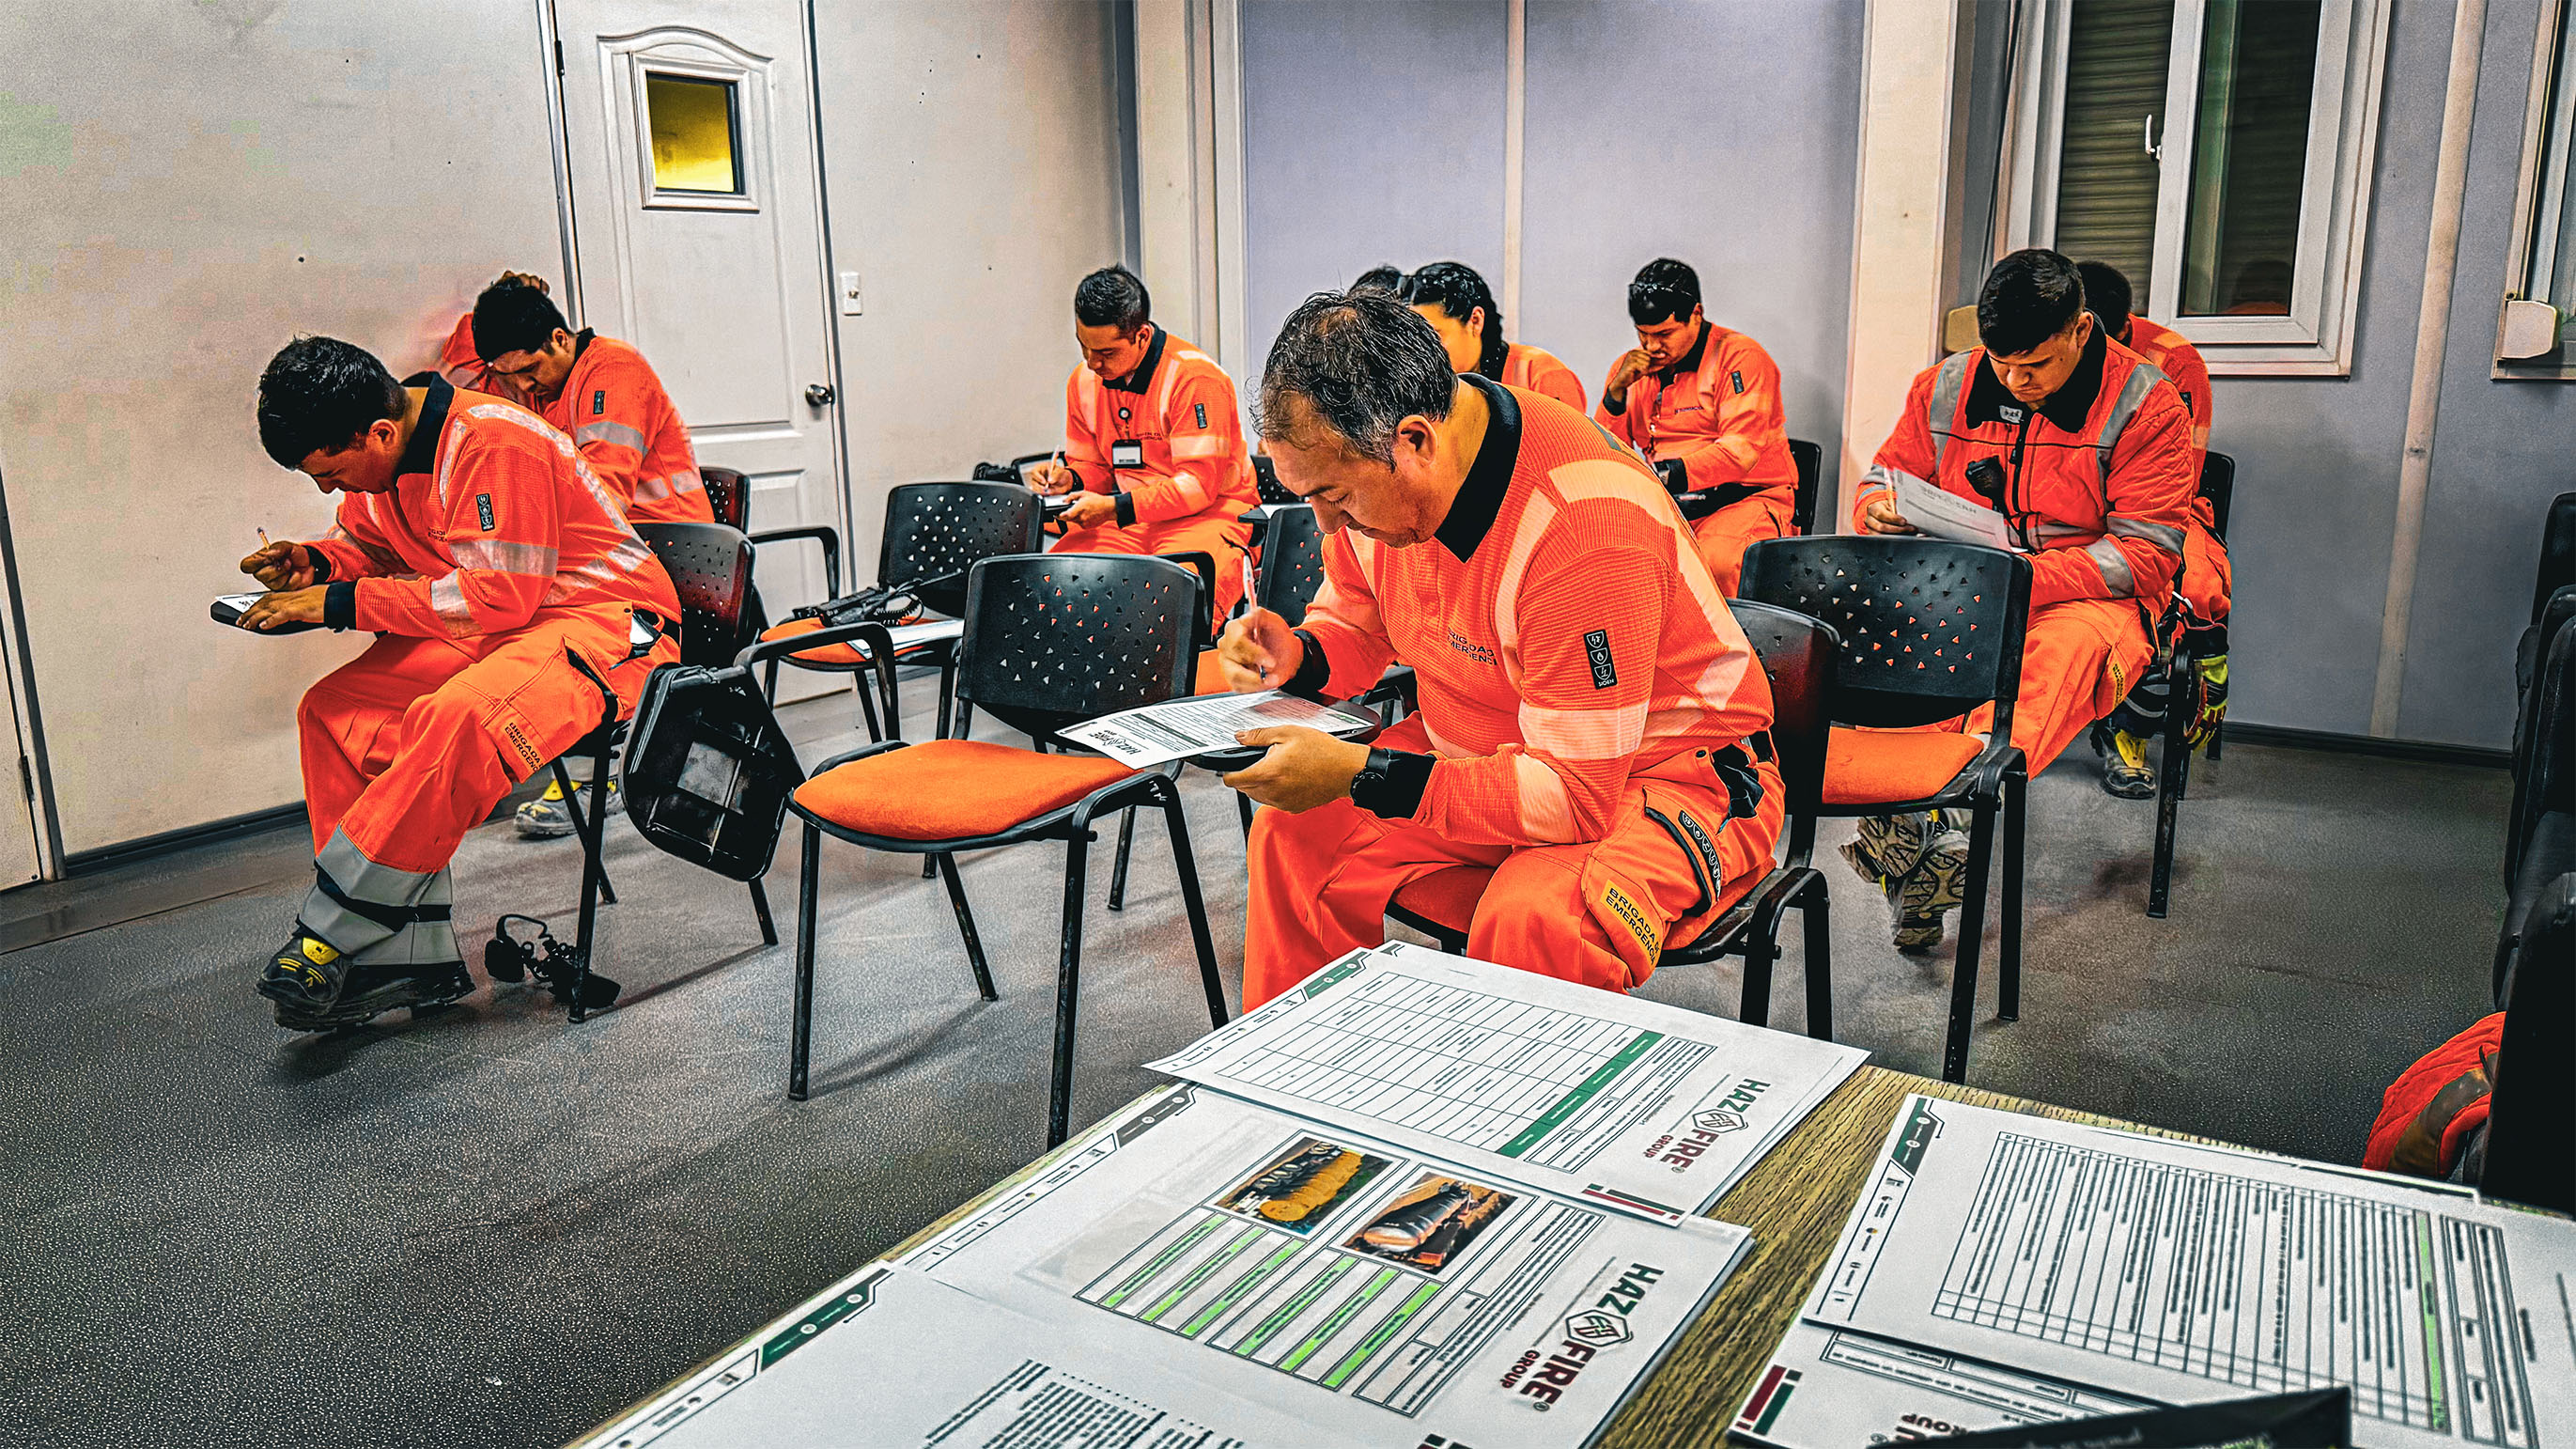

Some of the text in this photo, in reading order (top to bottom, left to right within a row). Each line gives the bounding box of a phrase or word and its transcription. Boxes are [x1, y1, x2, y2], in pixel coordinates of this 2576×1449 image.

[504, 726, 539, 771] EMERGENC
[509, 722, 541, 764] BRIGADA
[1608, 887, 1655, 943] BRIGADA
[1716, 1078, 1771, 1113] HAZ
[1644, 1134, 1674, 1159] GROUP
[1596, 1262, 1665, 1316] HAZ
[1499, 1349, 1541, 1389] GROUP
